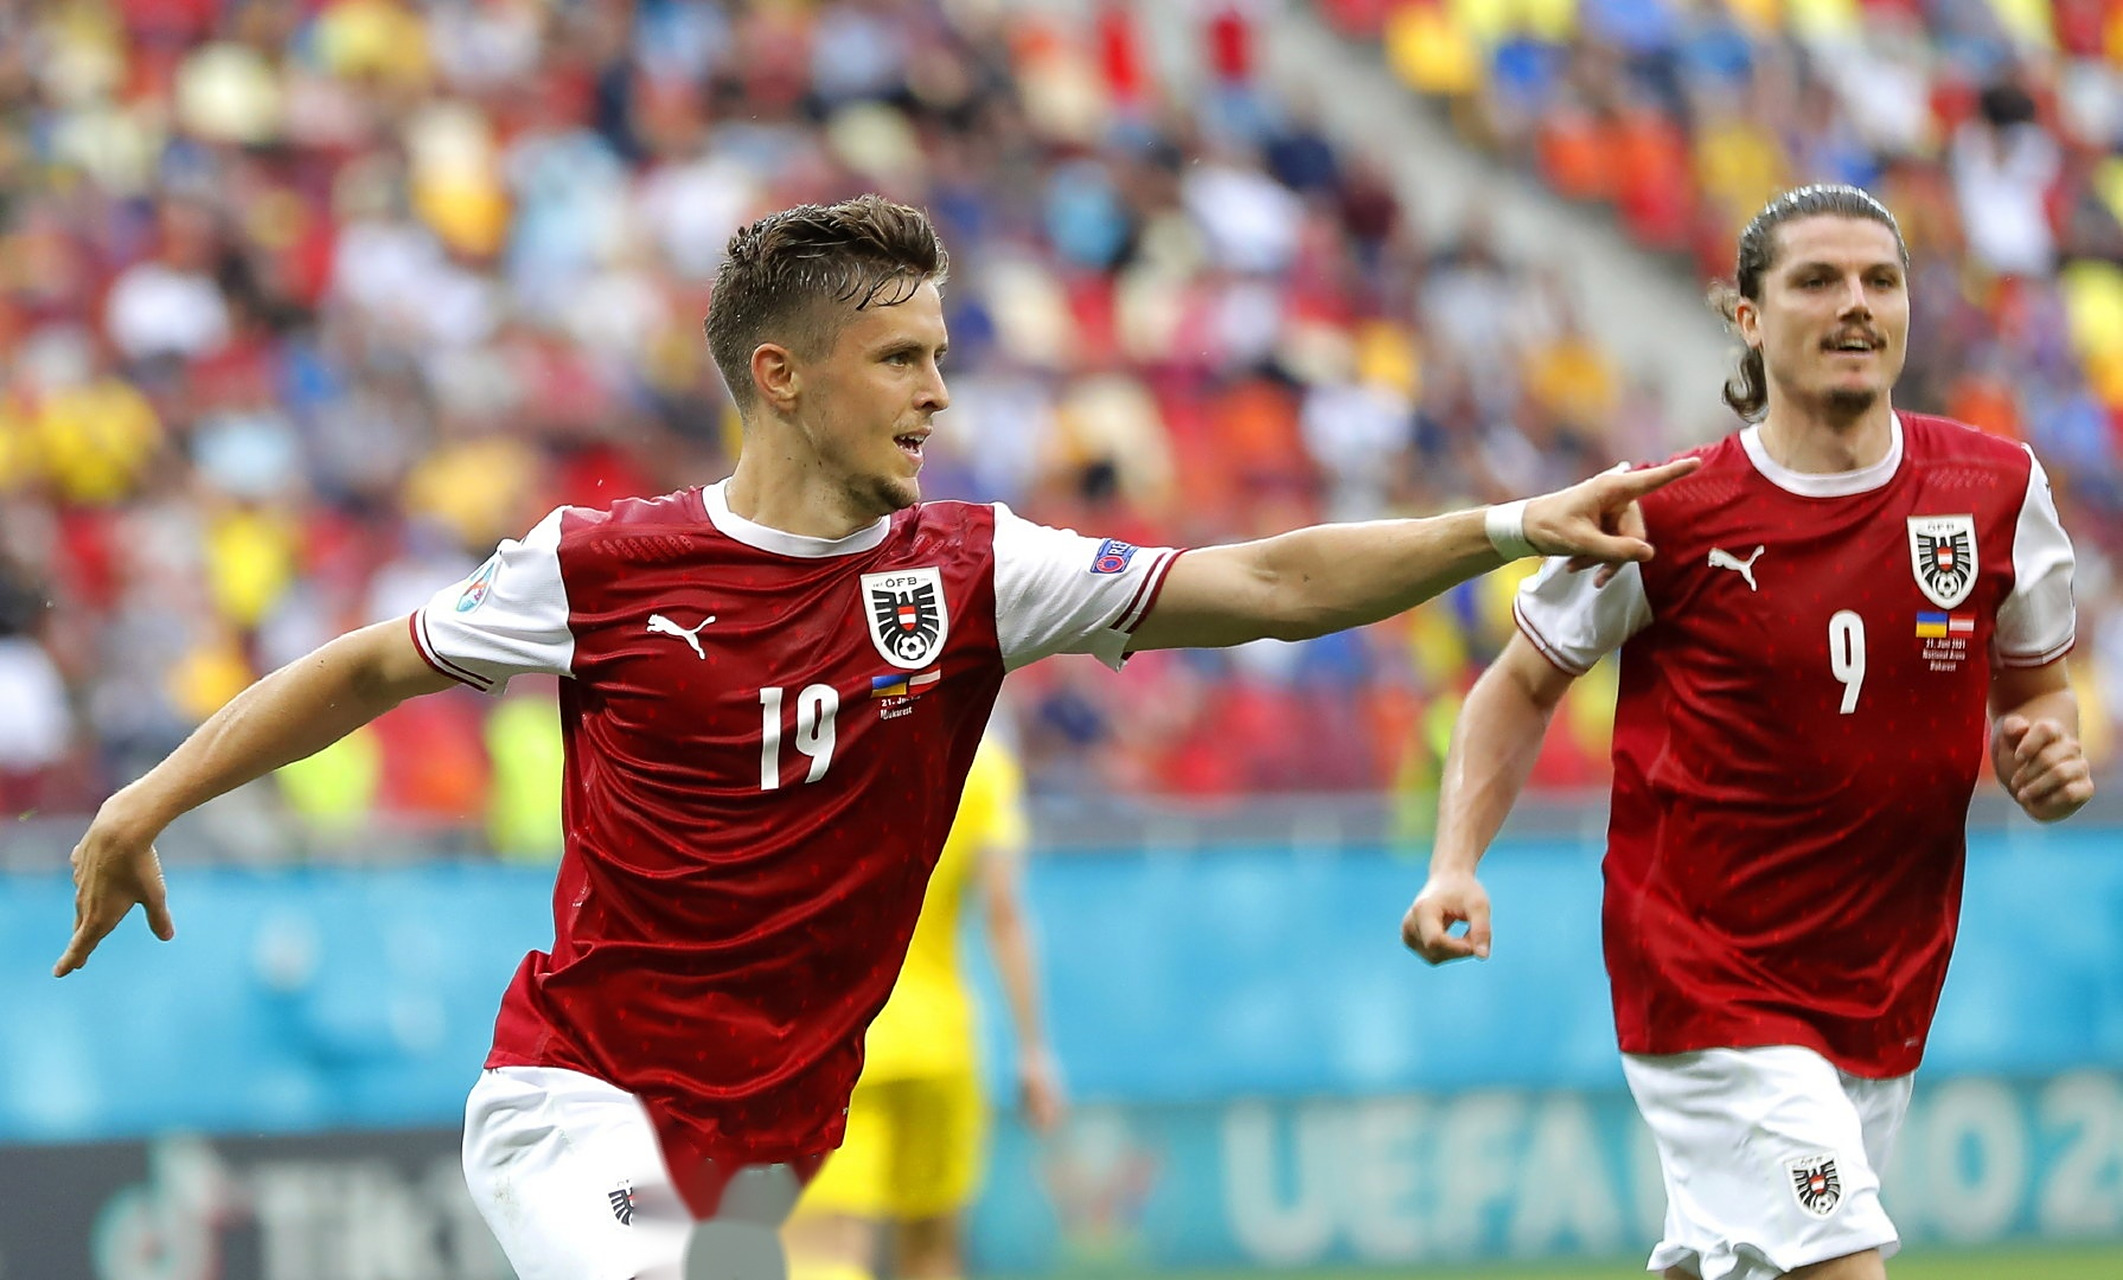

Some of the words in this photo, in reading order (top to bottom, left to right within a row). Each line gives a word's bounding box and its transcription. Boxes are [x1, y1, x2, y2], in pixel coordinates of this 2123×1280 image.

[1828, 609, 1866, 715] 9
[760, 683, 839, 791] 19
[1223, 1088, 1622, 1262] UEFA
